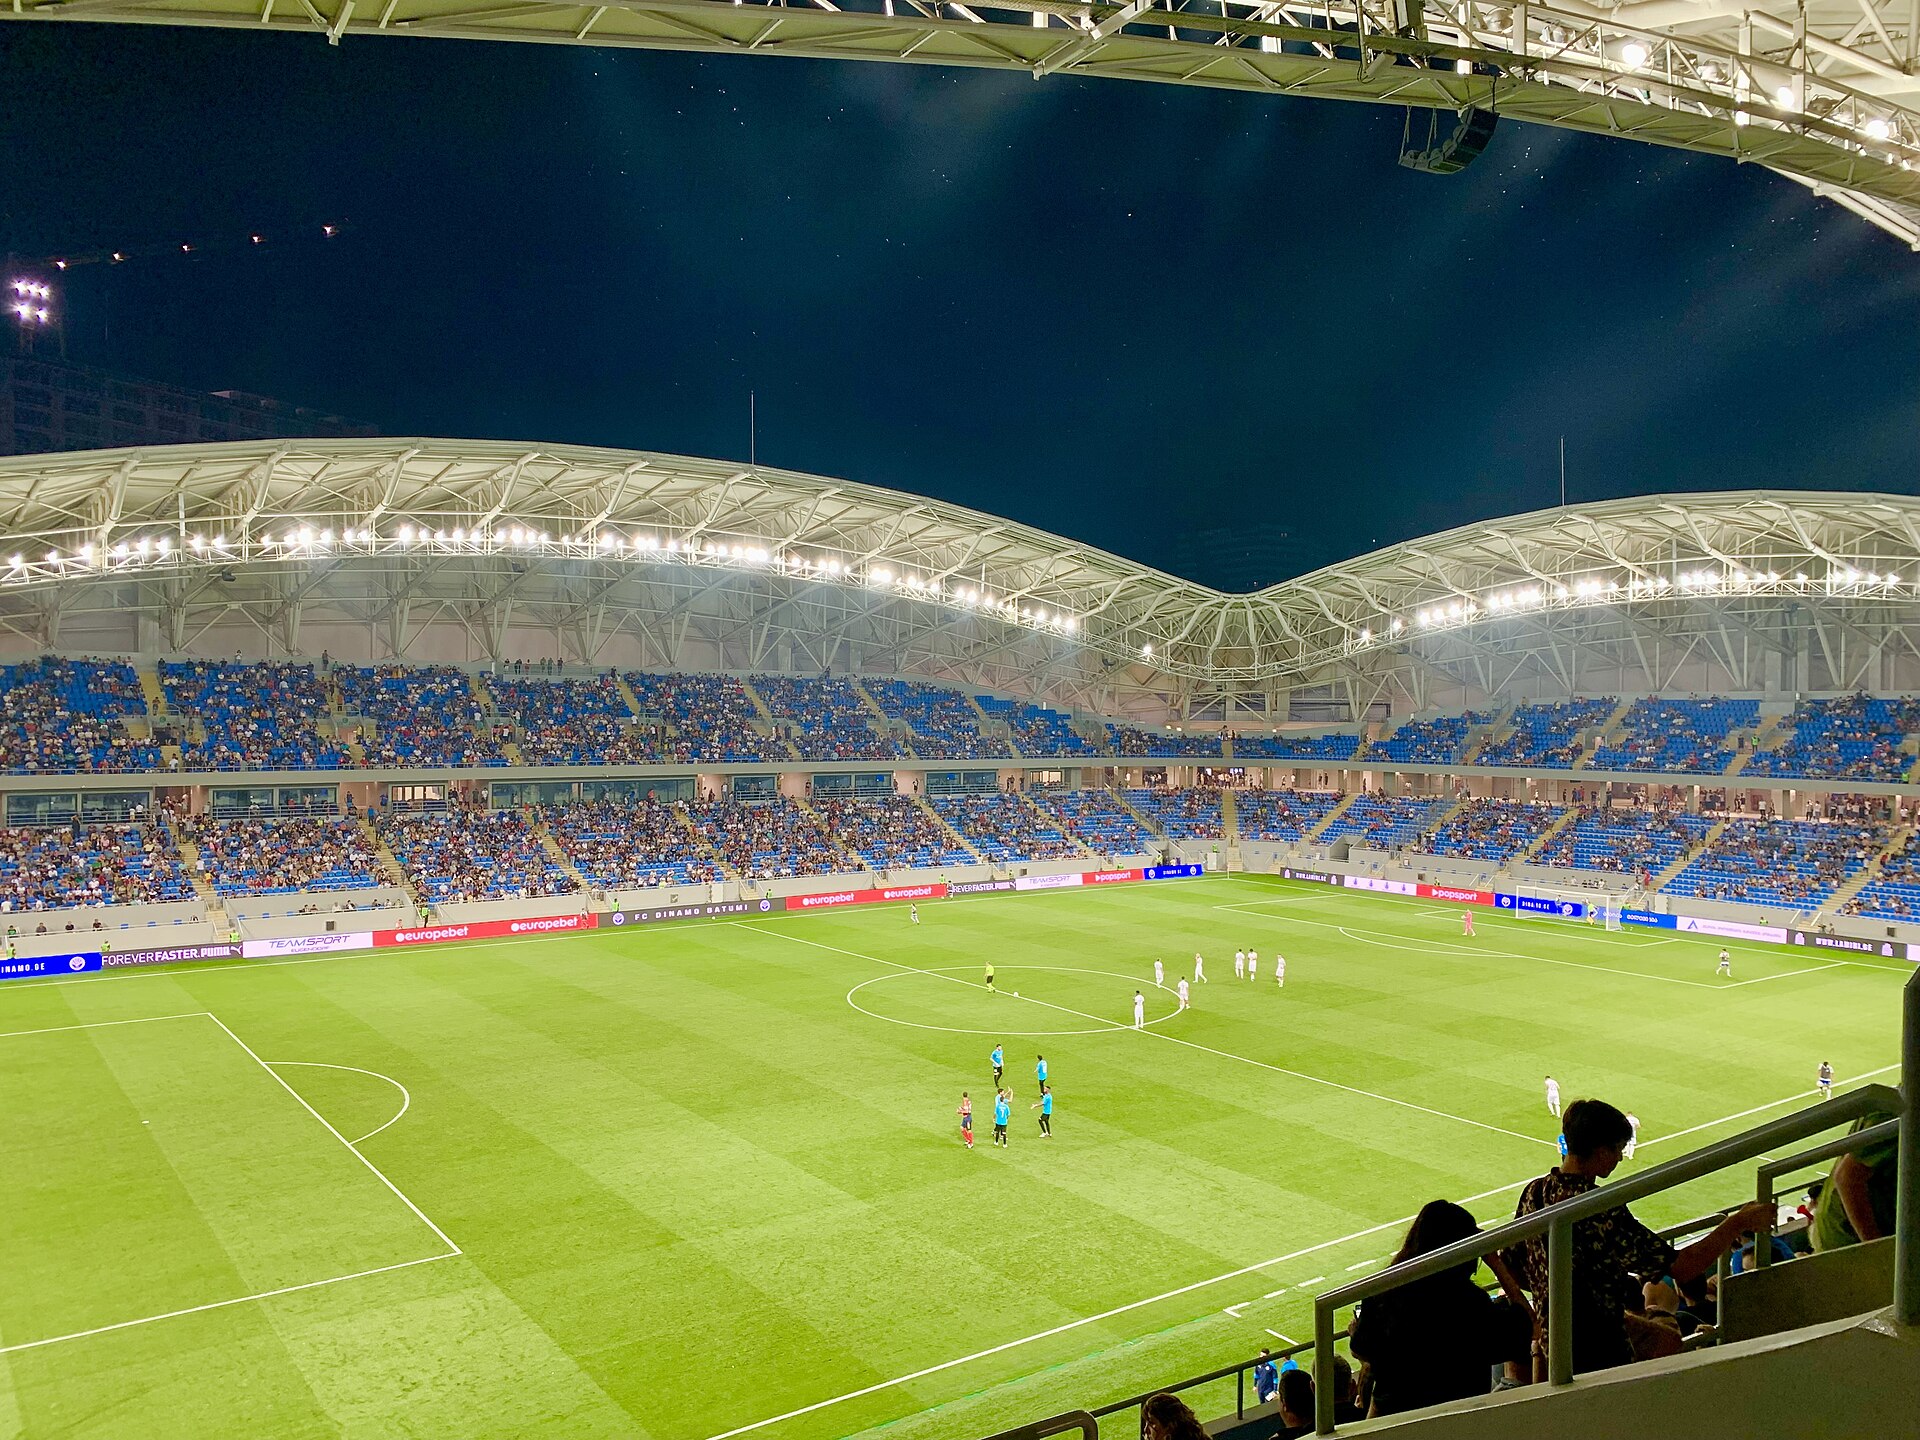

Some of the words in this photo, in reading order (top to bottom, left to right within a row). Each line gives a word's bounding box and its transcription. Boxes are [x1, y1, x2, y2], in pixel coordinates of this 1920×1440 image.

[1101, 871, 1131, 881] popsport
[809, 893, 854, 905] europebet
[890, 887, 932, 899] europebet
[1438, 889, 1477, 901] popsport
[634, 913, 648, 921] FC
[655, 908, 700, 919] DINAMO
[707, 904, 748, 914] BATUMI
[518, 916, 578, 931] europebet
[405, 926, 468, 941] europebet
[269, 935, 350, 949] TEAMSPORT
[201, 946, 231, 957] PUMA
